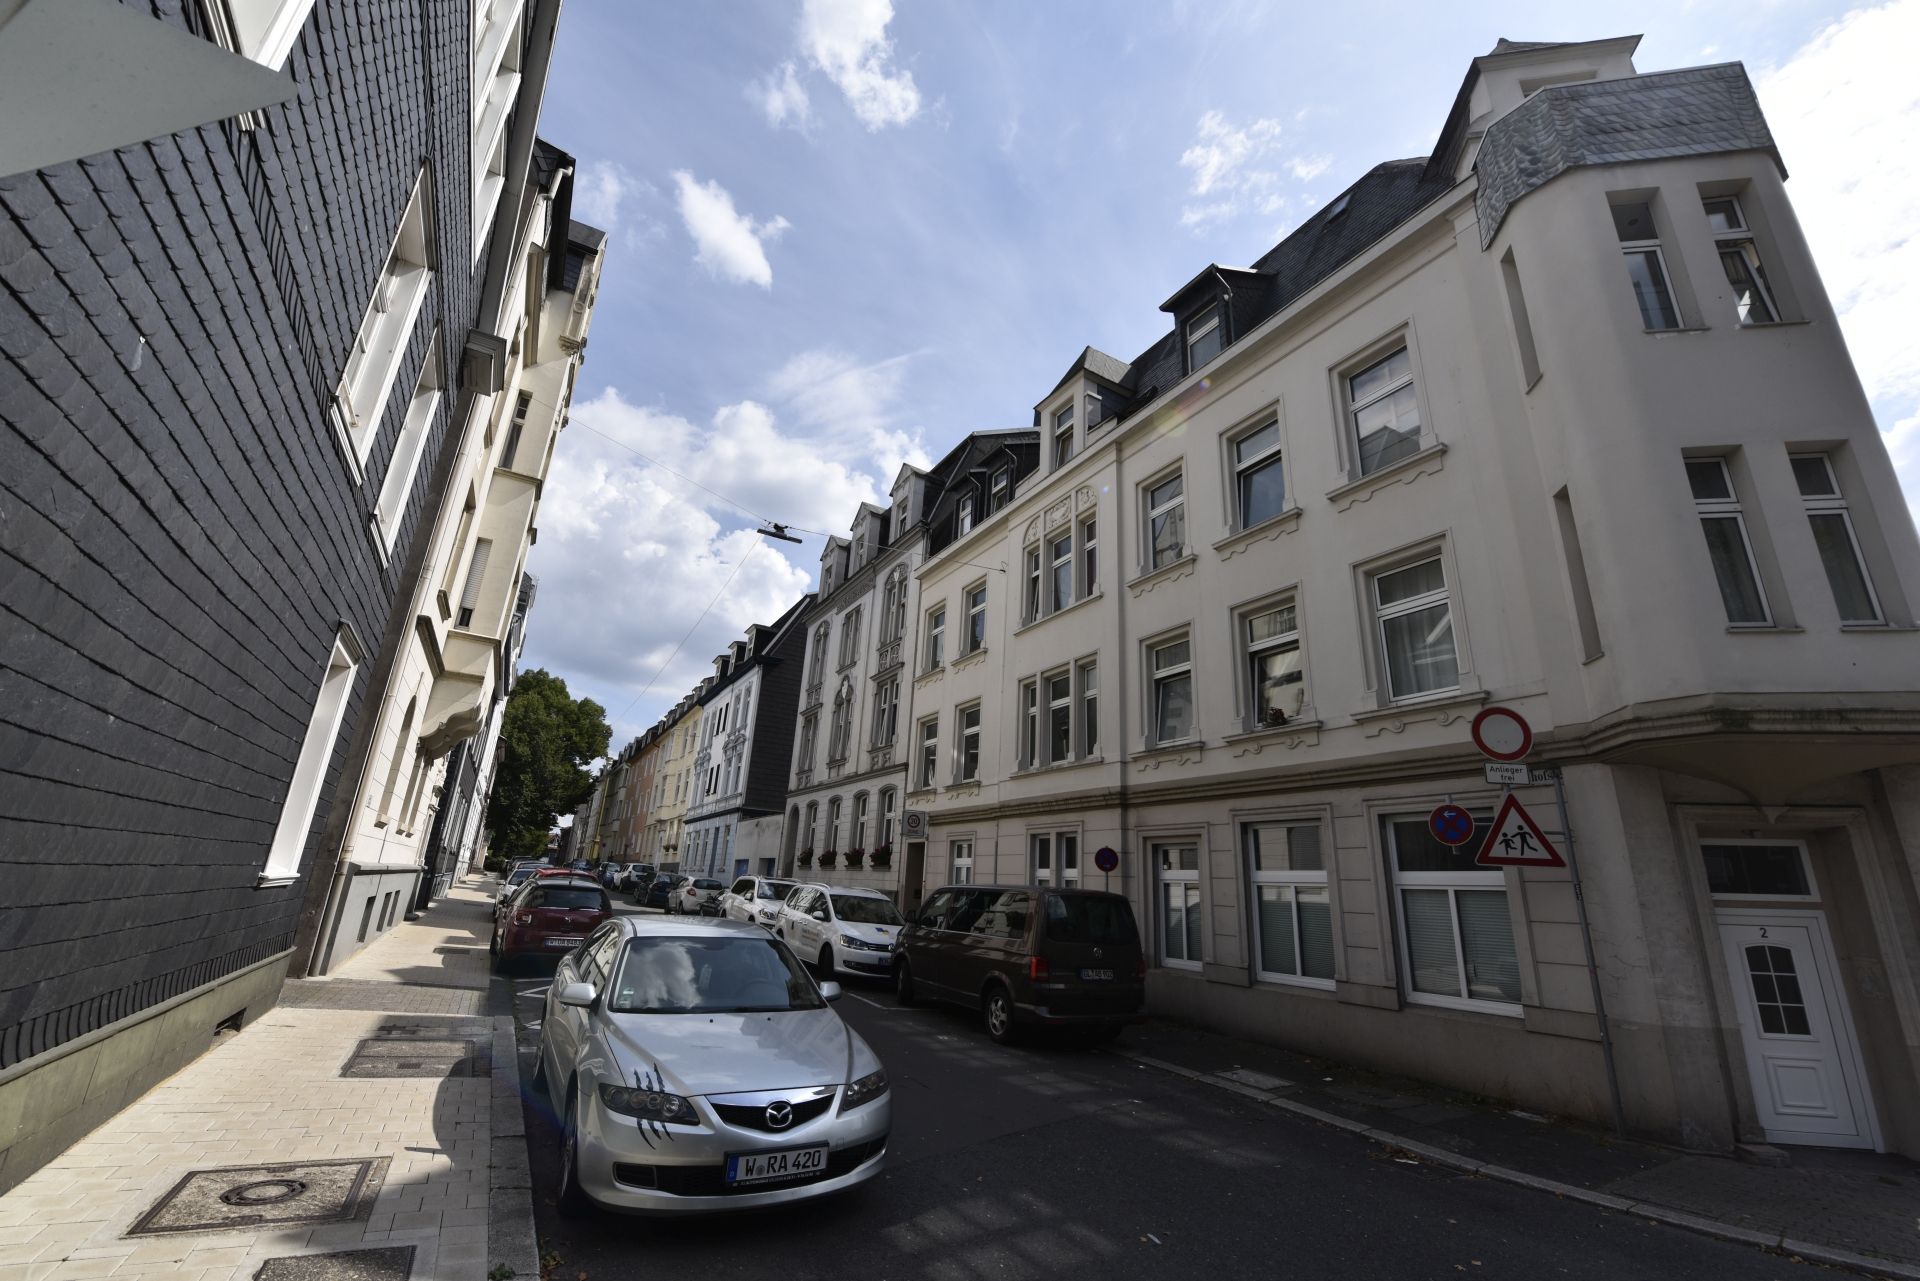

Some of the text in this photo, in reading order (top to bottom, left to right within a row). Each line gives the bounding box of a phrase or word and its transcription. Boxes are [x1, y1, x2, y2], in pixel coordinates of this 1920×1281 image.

[1489, 765, 1524, 775] Anlieger
[1500, 774, 1515, 782] frei
[1759, 927, 1769, 939] 2
[745, 1150, 822, 1177] W RA 420
